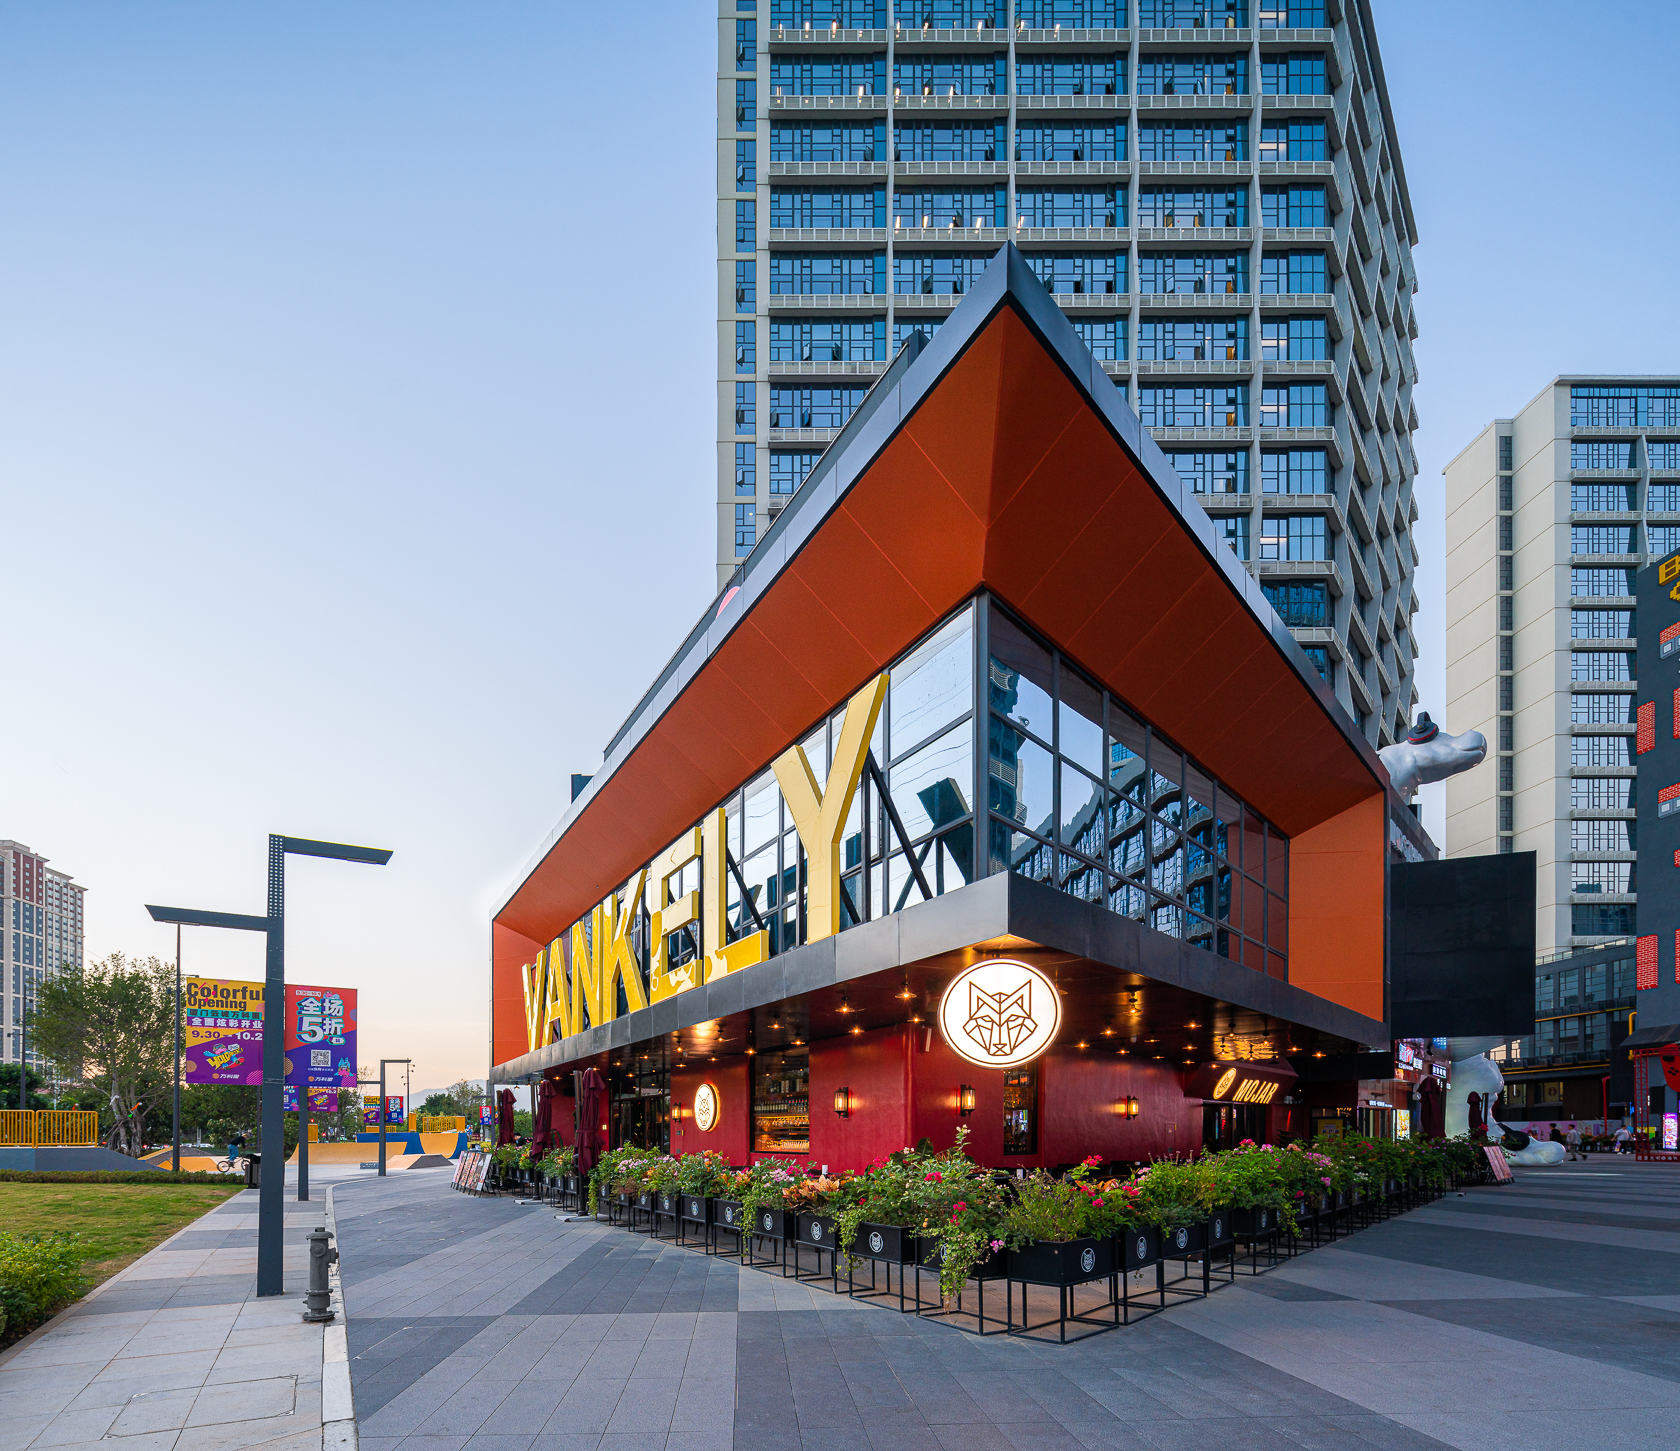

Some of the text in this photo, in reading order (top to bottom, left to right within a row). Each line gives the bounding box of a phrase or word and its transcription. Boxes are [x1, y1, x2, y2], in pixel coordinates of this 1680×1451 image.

[521, 674, 890, 1053] VANKELY
[186, 982, 265, 1001] Colorful
[187, 995, 247, 1011] Opening
[298, 997, 344, 1017] 全场
[191, 1017, 263, 1029] 全面炫彩开业
[1232, 1078, 1280, 1105] MOJAR
